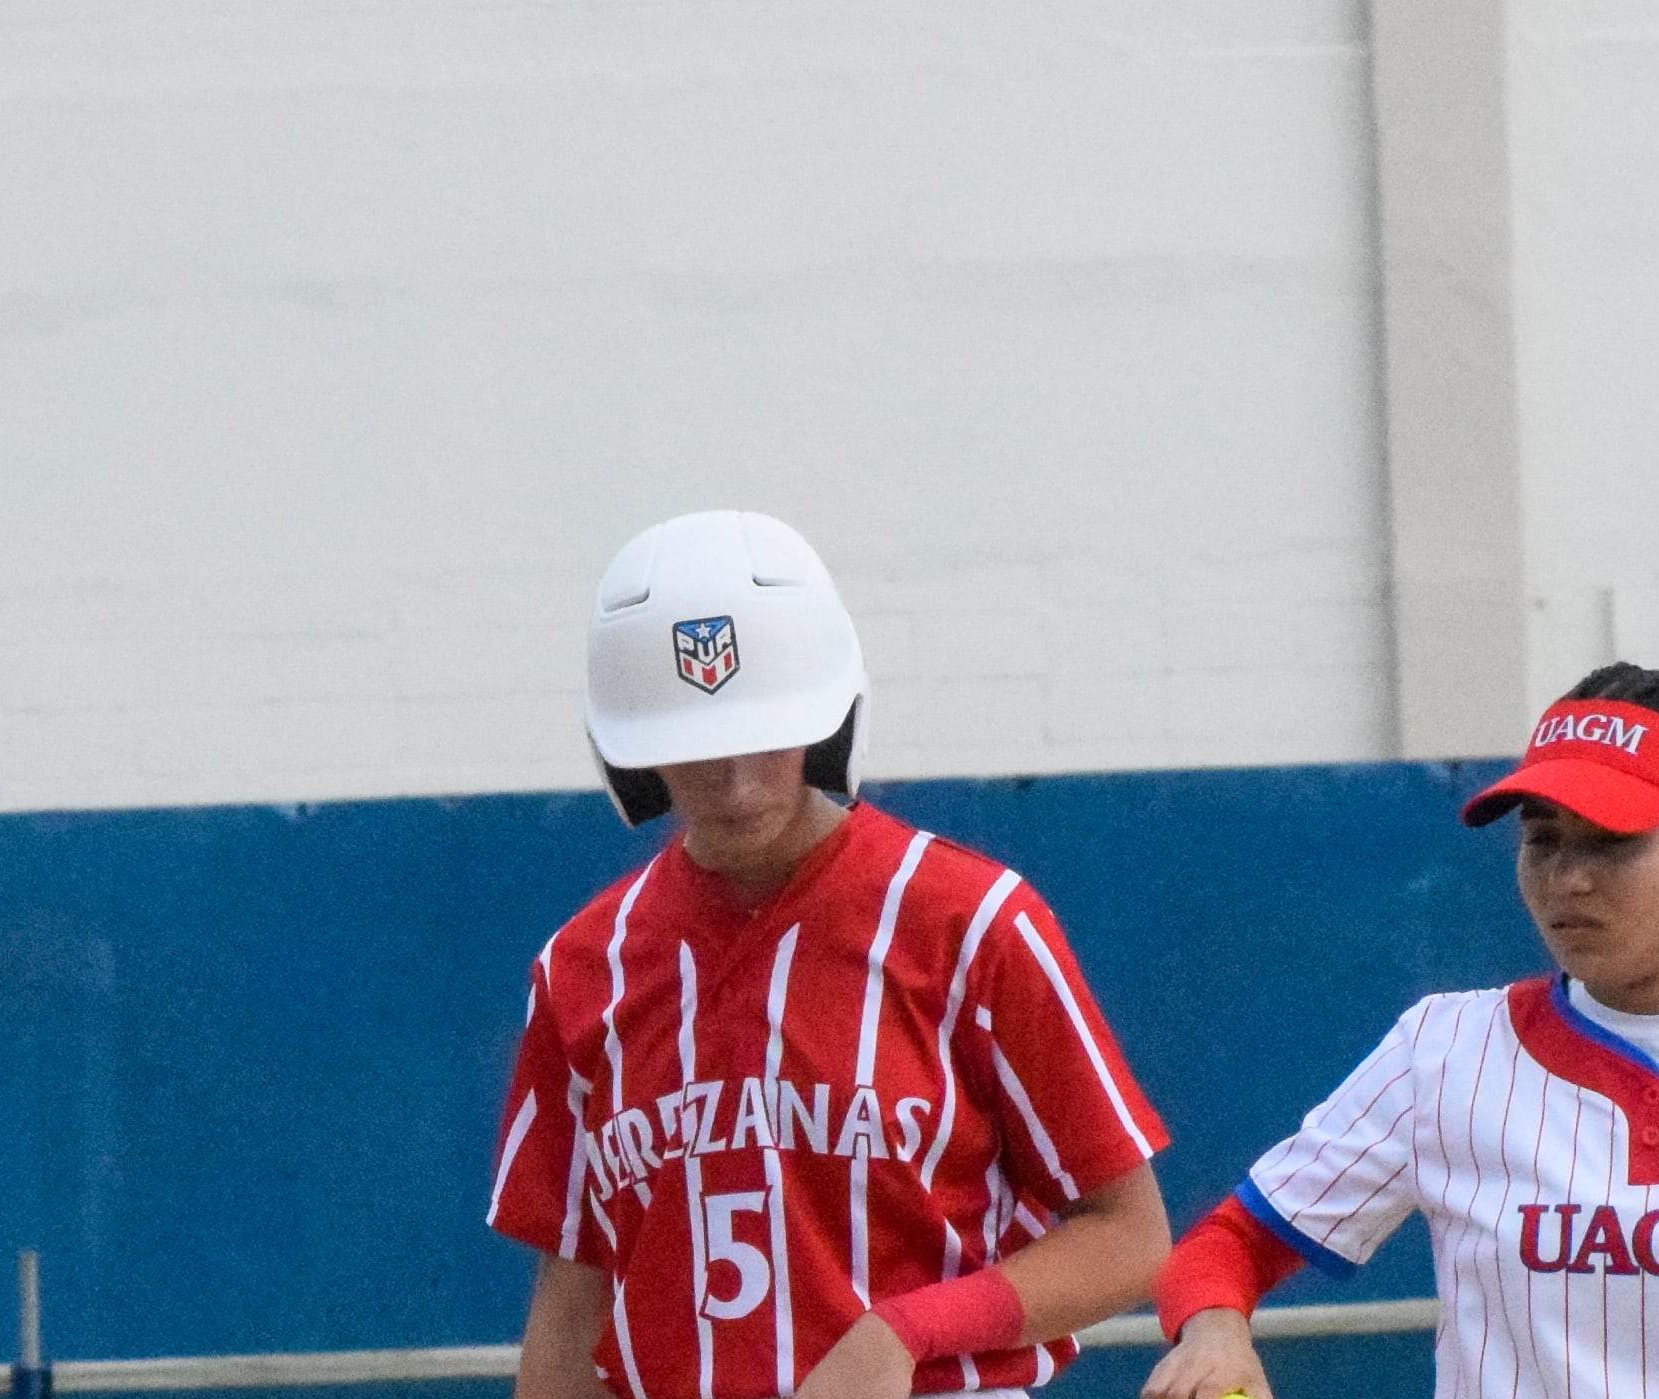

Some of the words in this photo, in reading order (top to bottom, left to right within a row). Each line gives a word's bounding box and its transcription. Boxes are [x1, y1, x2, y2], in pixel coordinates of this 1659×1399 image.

[1534, 713, 1648, 757] UAGM
[585, 1076, 932, 1203] JEREZANAS
[699, 1186, 771, 1320] 5
